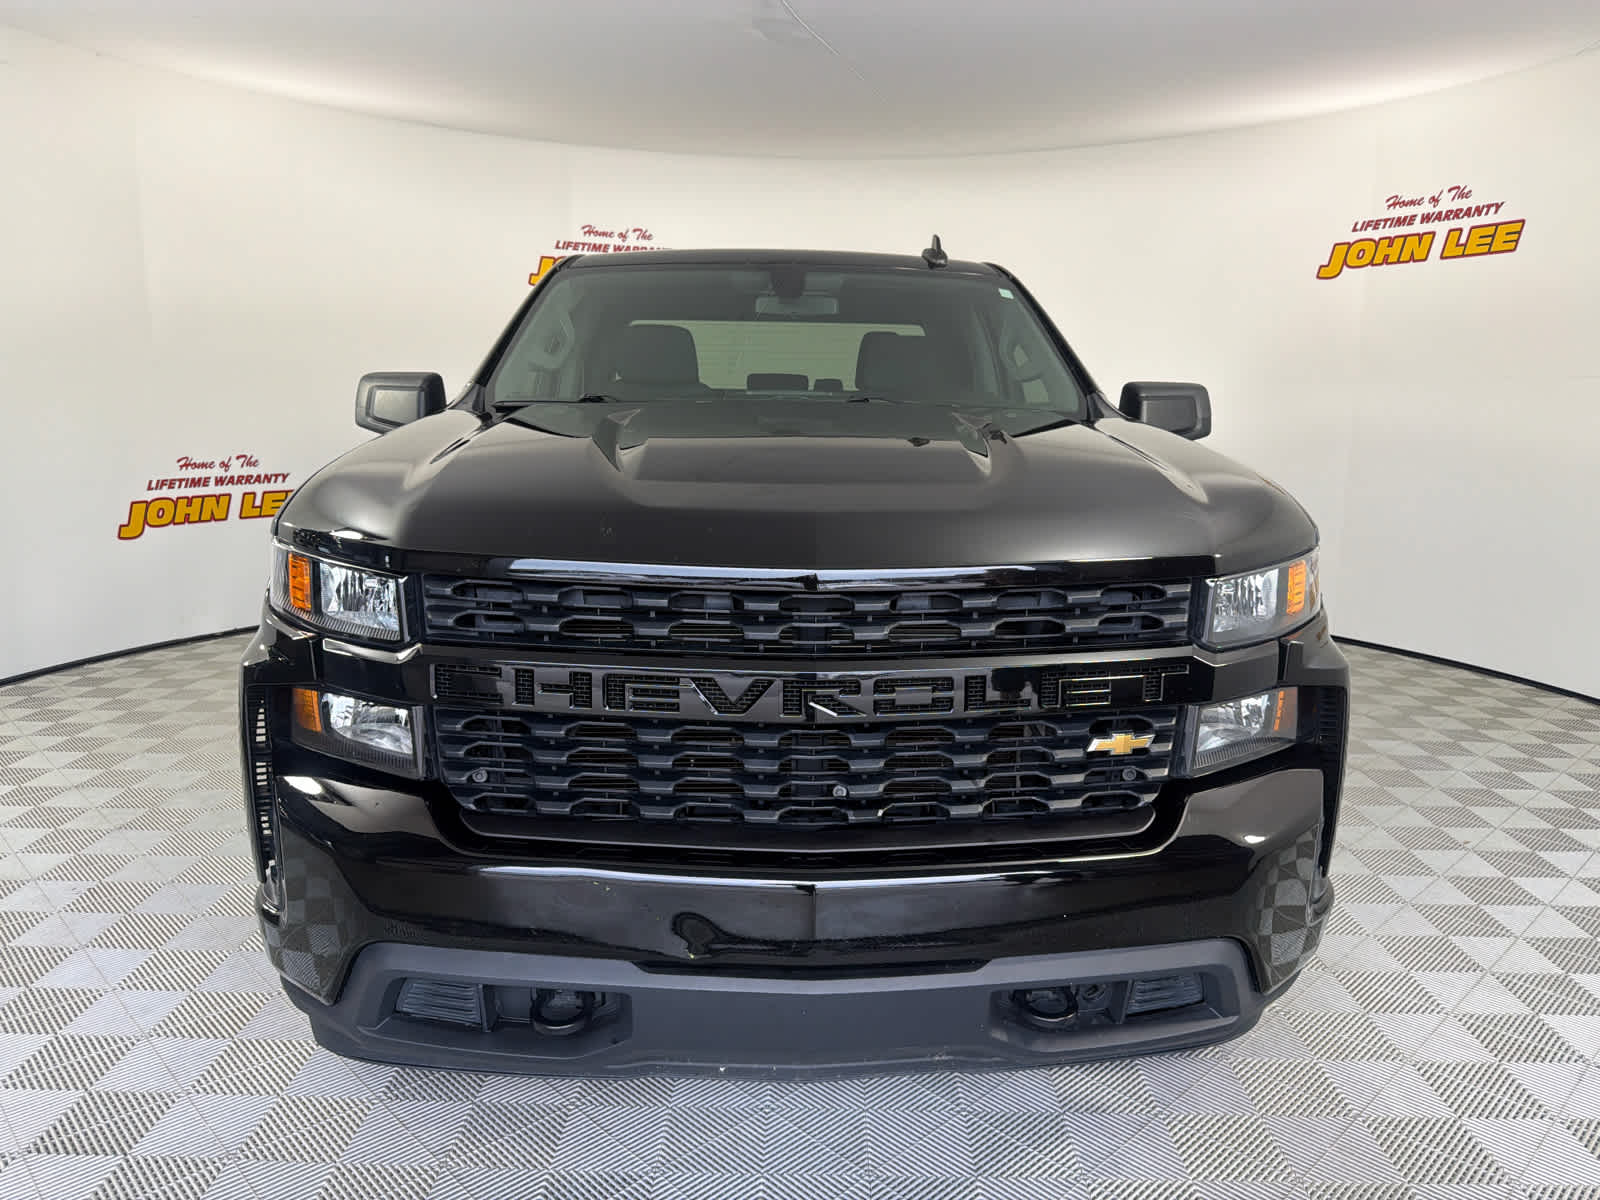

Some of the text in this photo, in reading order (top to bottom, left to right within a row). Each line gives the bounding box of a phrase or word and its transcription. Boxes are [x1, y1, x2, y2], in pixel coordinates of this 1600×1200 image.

[1385, 185, 1472, 210] Home of The
[1351, 202, 1505, 233] LIFETIME WARRANTY
[581, 224, 654, 242] Home of The
[555, 240, 610, 253] LIFETIME
[1316, 219, 1526, 279] JOHN LEE
[176, 454, 259, 472] Home of The
[147, 473, 290, 491] LIFETIME WARRANTY
[118, 489, 294, 540] JOHN LE
[433, 663, 1190, 717] CHEVROLET
